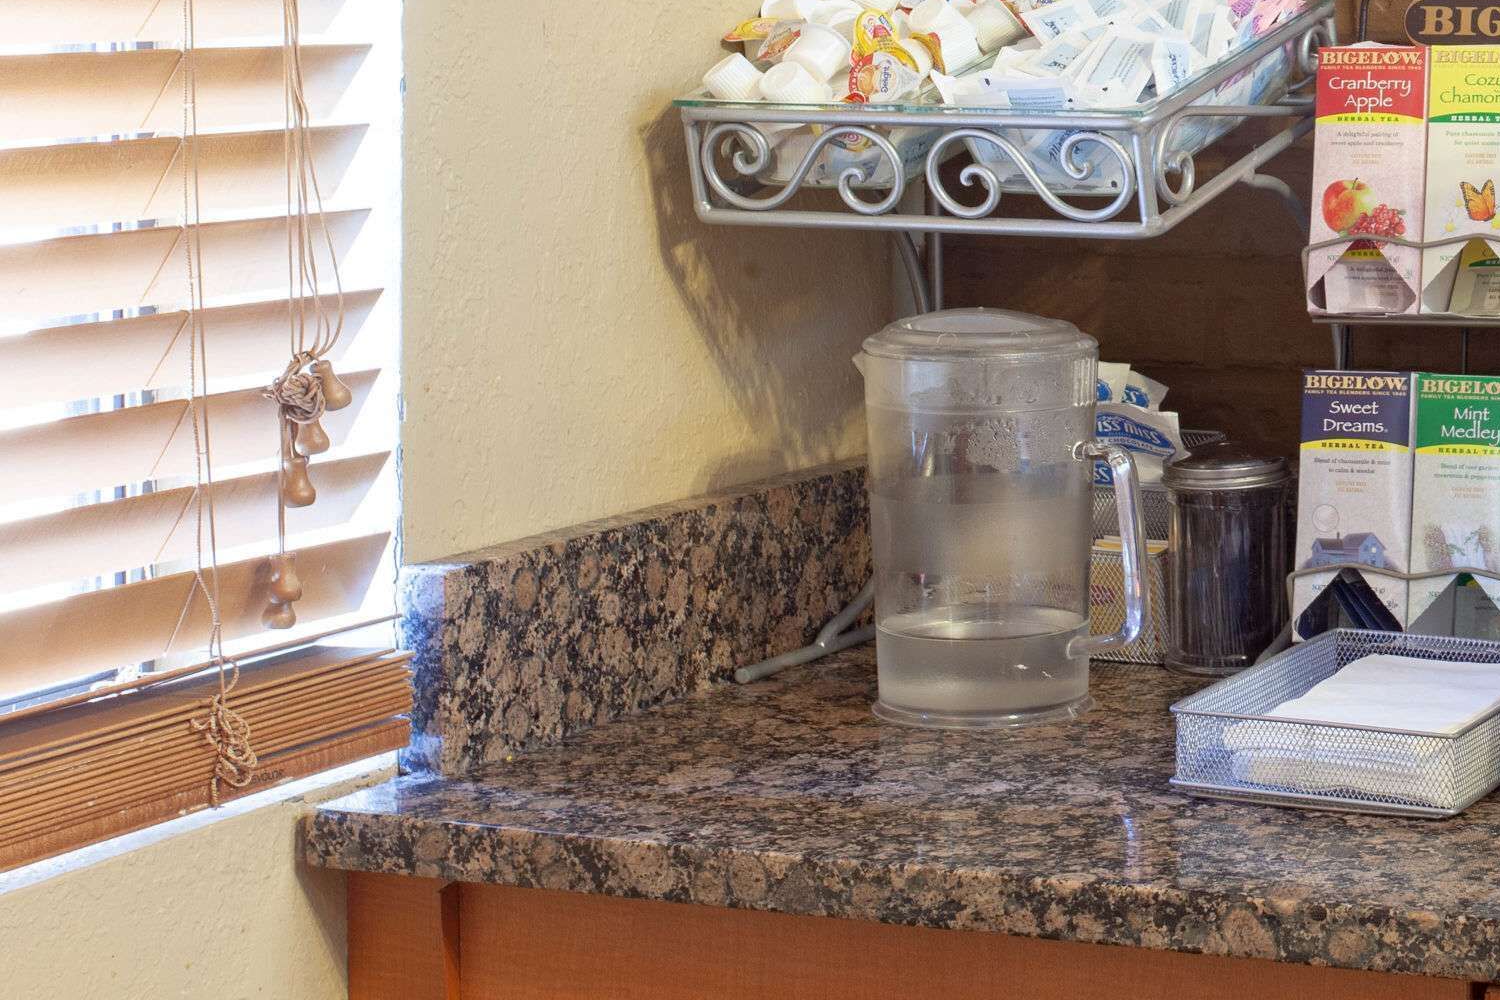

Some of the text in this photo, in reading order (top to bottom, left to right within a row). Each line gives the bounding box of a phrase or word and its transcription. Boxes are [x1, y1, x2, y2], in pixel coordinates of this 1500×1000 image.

[1321, 51, 1420, 65] BIGELOW
[1328, 71, 1411, 97] Cranberry
[1344, 88, 1393, 113] Apple
[1304, 374, 1408, 391] BIGELOW
[1329, 400, 1380, 414] Sweet
[1454, 406, 1490, 421] Mint
[1323, 418, 1385, 433] Dreams
[1441, 420, 1500, 447] Medley
